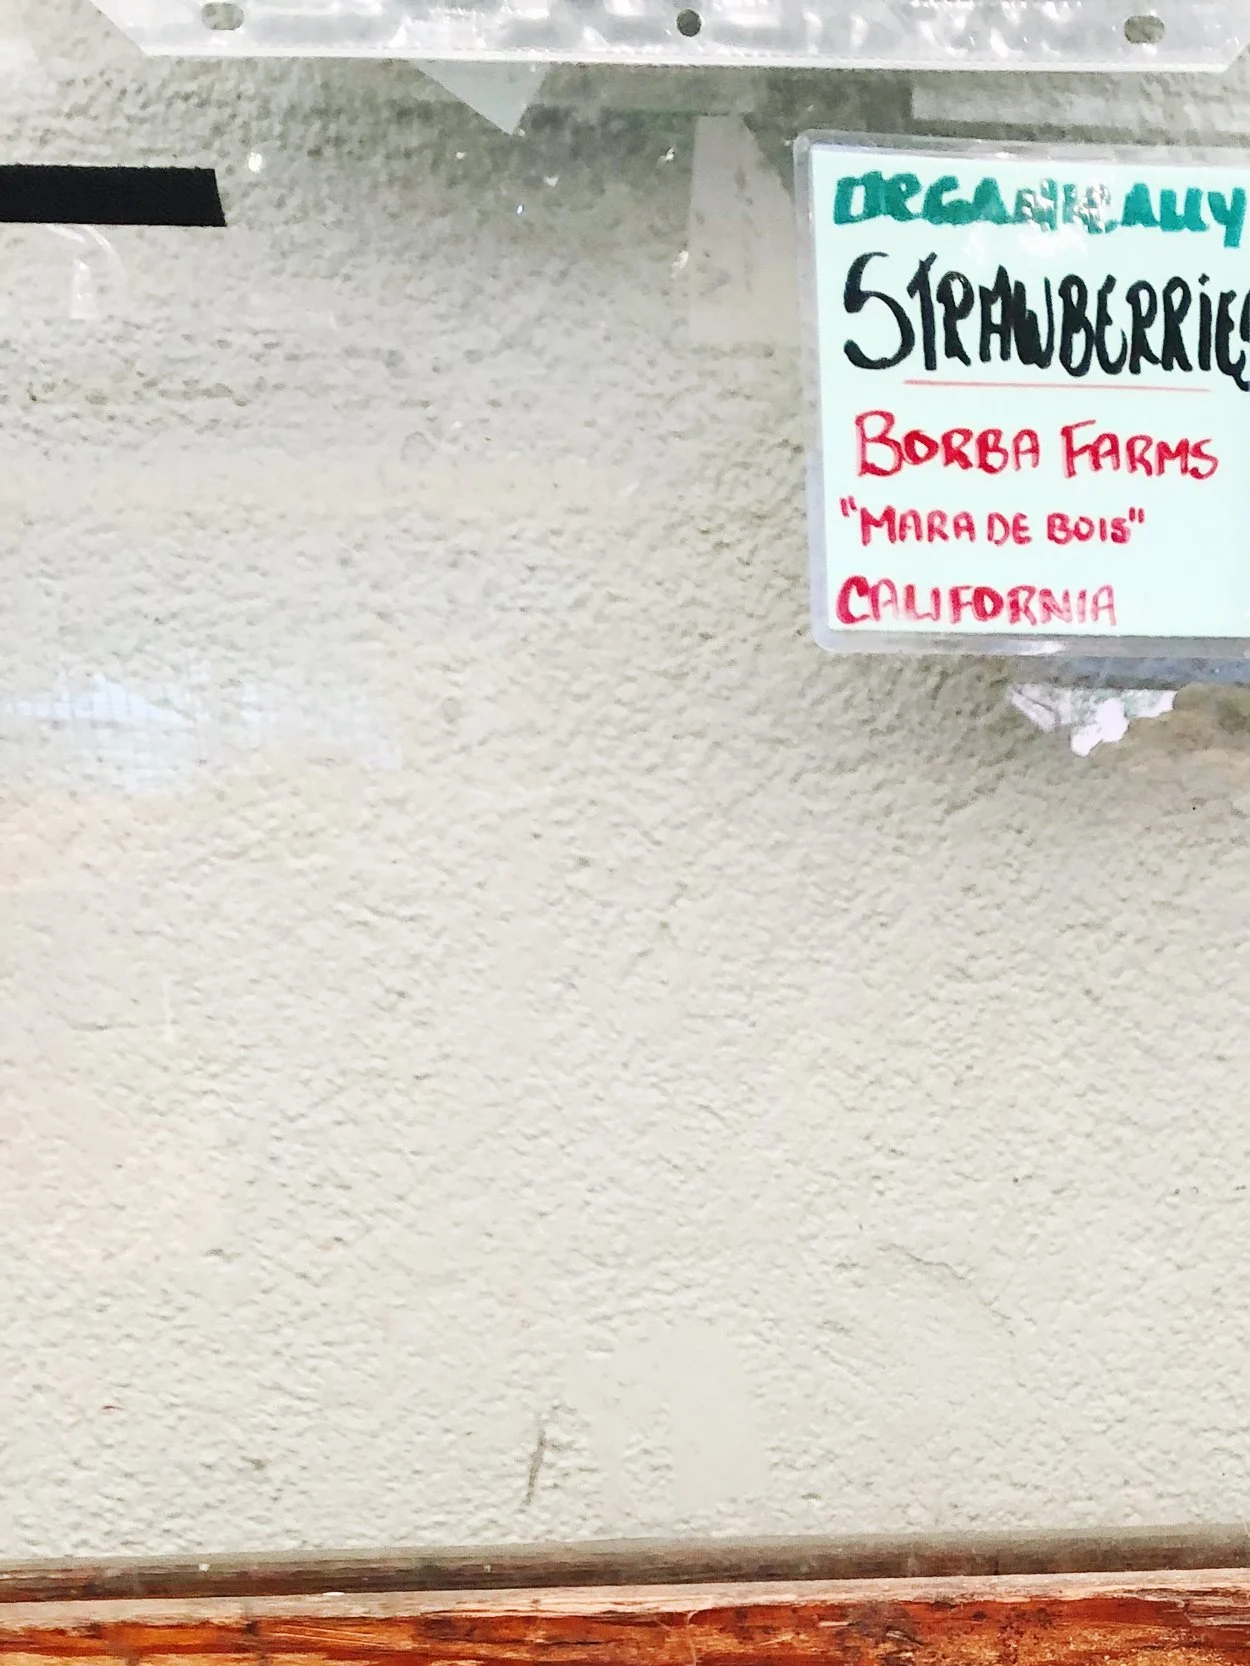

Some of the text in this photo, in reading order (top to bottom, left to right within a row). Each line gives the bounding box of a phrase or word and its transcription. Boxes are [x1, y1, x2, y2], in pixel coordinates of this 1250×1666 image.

[855, 410, 1220, 480] BORBA FARMS
[987, 511, 1033, 545] DE
[836, 575, 1119, 627] CALIFORNIA
